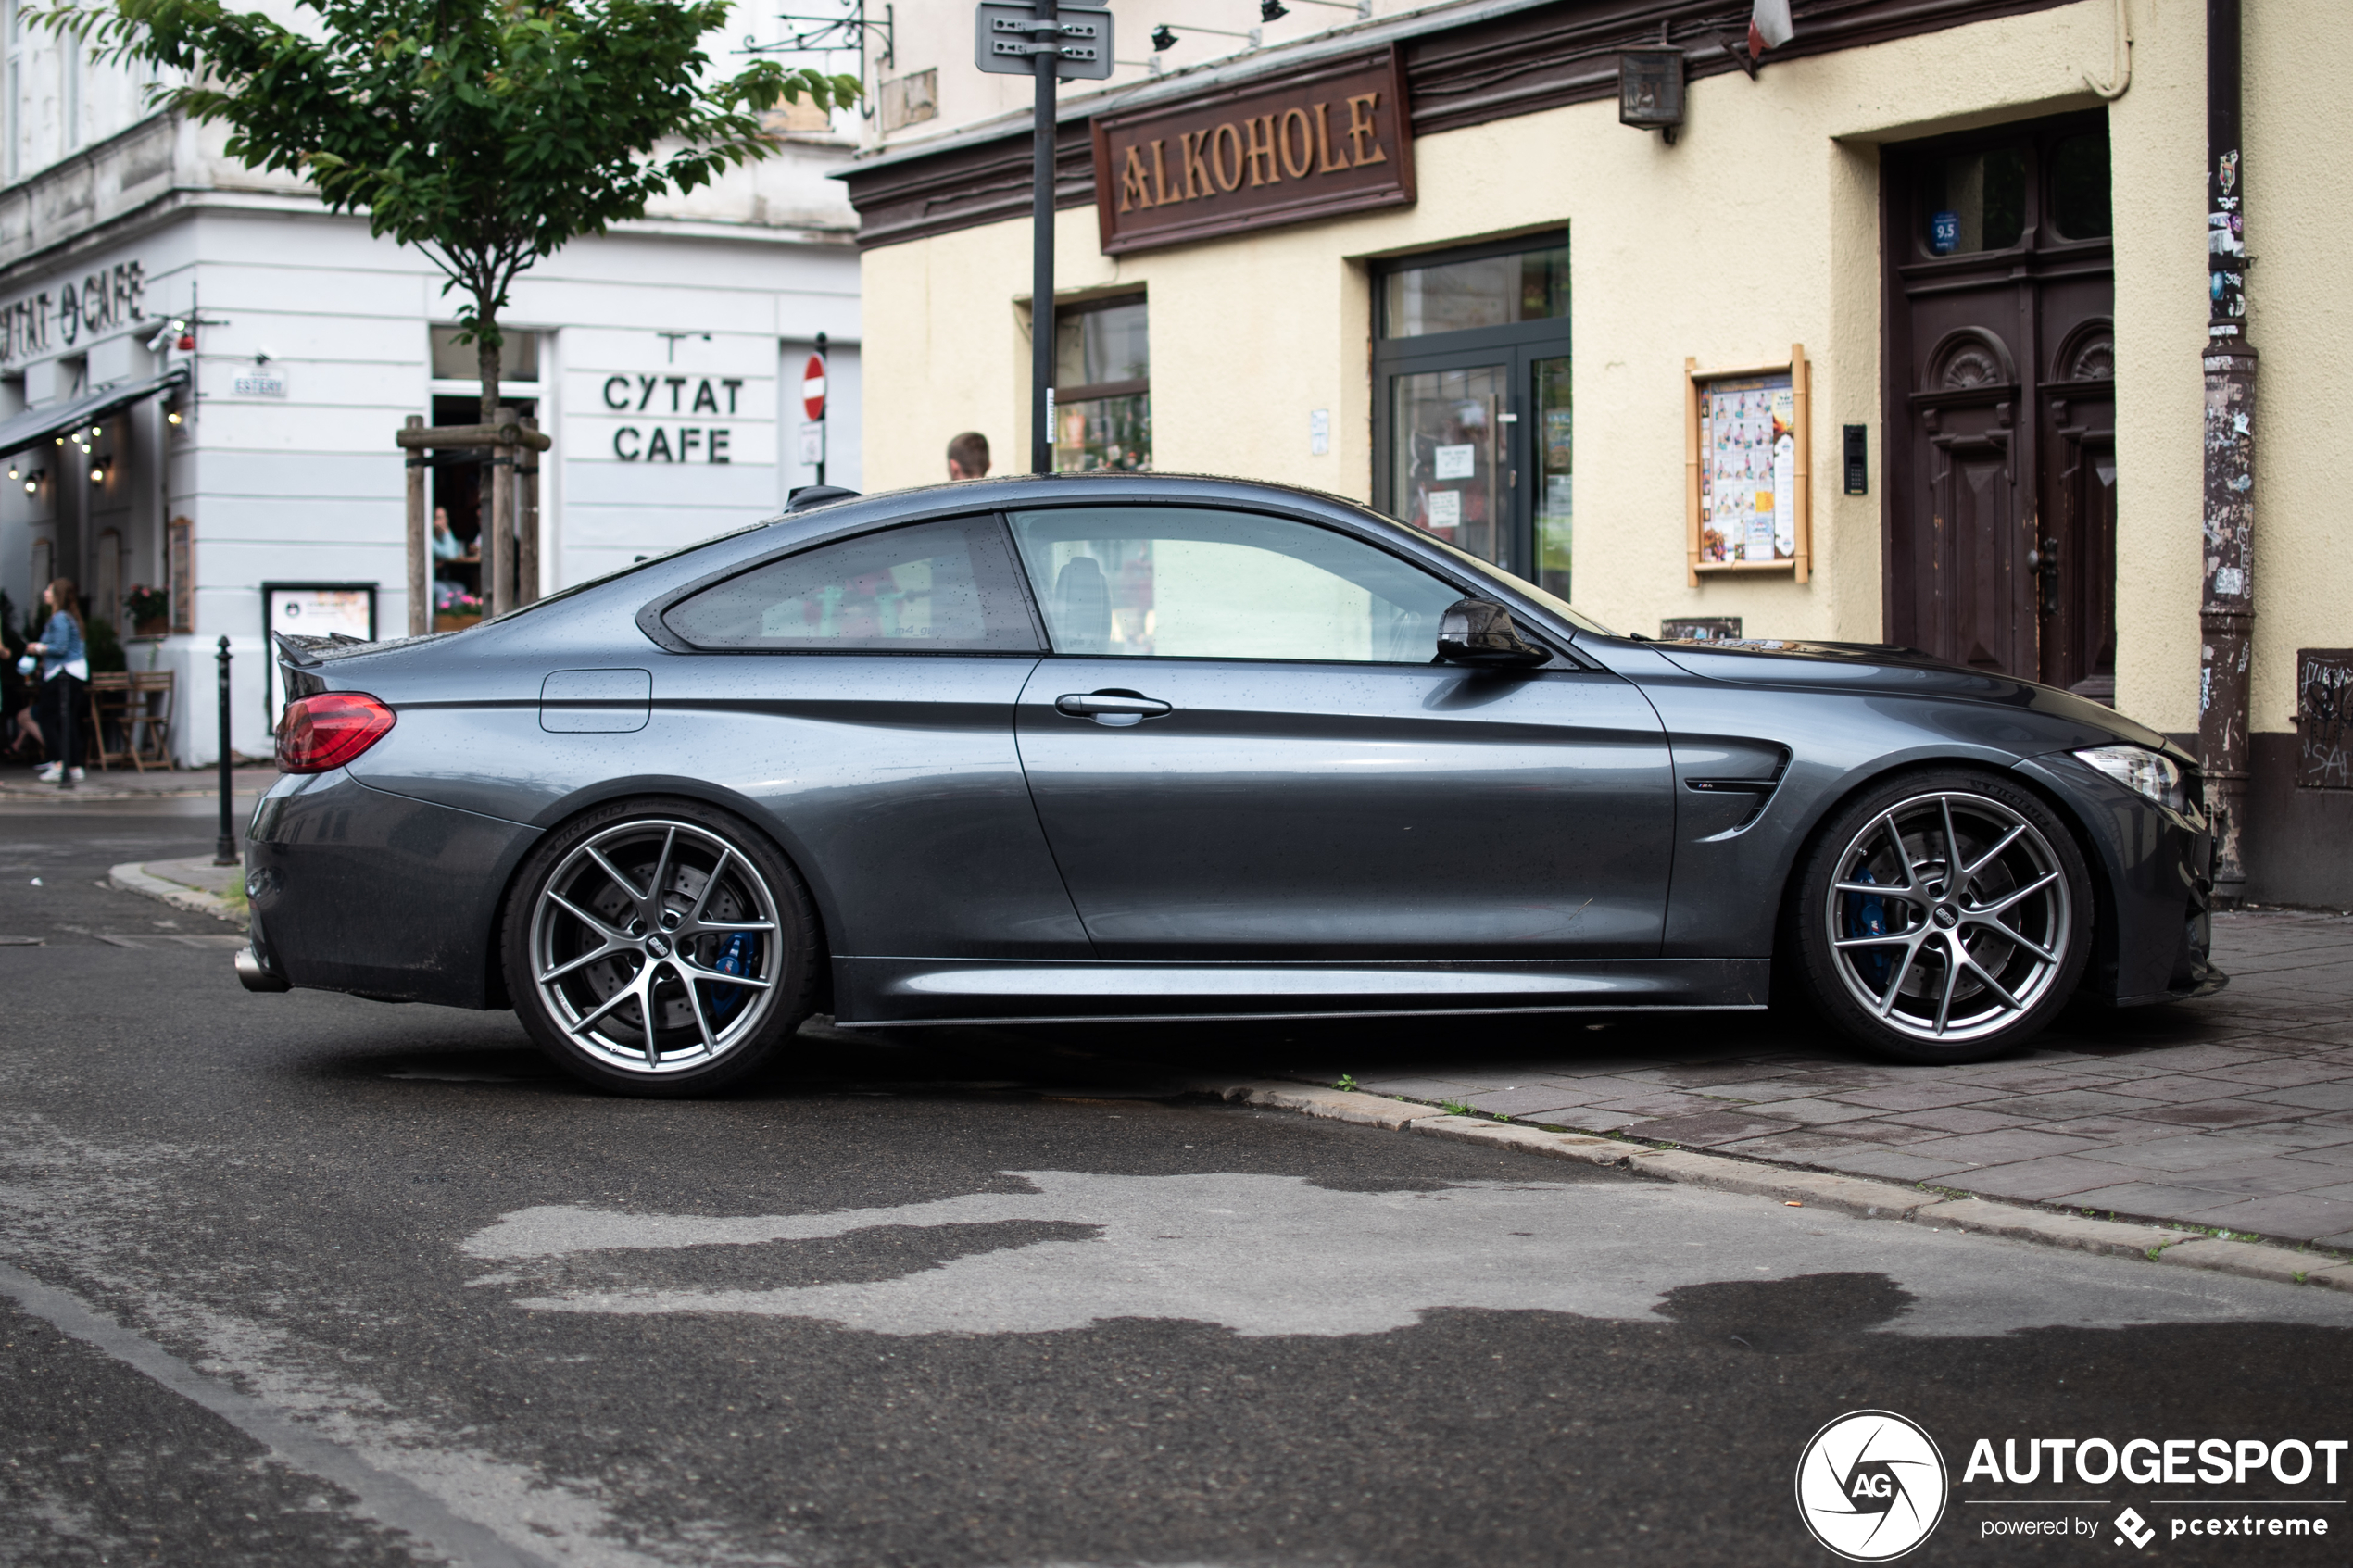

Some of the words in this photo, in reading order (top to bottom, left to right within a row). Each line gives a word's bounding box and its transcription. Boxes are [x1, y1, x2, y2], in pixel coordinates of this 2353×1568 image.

[1119, 92, 1388, 214] ALKOHOLE
[82, 259, 145, 332] CAFE
[234, 378, 282, 394] ESTERY
[603, 375, 743, 413] CYTAT
[613, 426, 731, 464] CAFE
[1988, 784, 2047, 824] MICHELIN
[554, 804, 623, 848] MICHELIN
[1935, 907, 1956, 926] BBS
[648, 936, 668, 957] BBS
